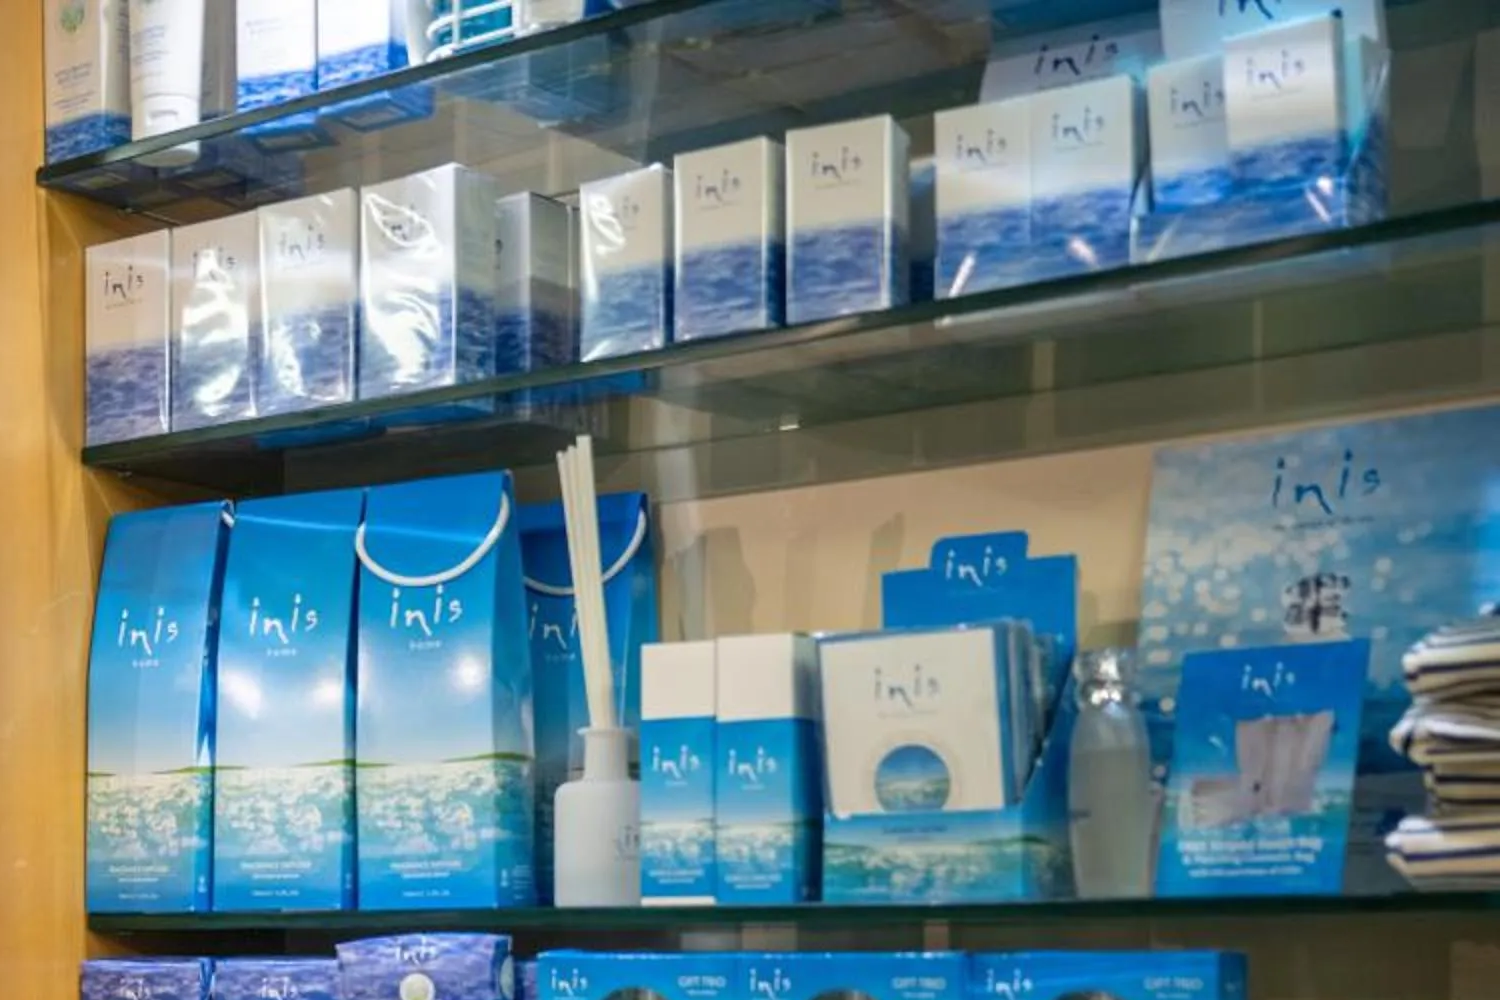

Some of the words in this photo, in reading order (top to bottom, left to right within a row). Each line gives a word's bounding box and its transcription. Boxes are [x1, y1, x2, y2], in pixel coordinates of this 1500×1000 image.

[1245, 49, 1305, 89] inis
[1170, 82, 1224, 117] inis
[1051, 106, 1105, 142] inis
[810, 145, 863, 180] inis
[955, 129, 1007, 163] inis
[695, 168, 741, 203] inis
[278, 224, 326, 261] inis
[104, 264, 145, 300] inis
[1272, 448, 1382, 515] inis
[946, 547, 1009, 587] inis
[250, 593, 319, 644] inis
[390, 584, 463, 637] inis
[118, 606, 179, 656] inis
[874, 663, 941, 707] inis
[1241, 661, 1296, 701] inis
[652, 744, 700, 779] inis
[729, 747, 778, 783] inis
[551, 967, 588, 997] inis
[750, 968, 792, 1000] inis
